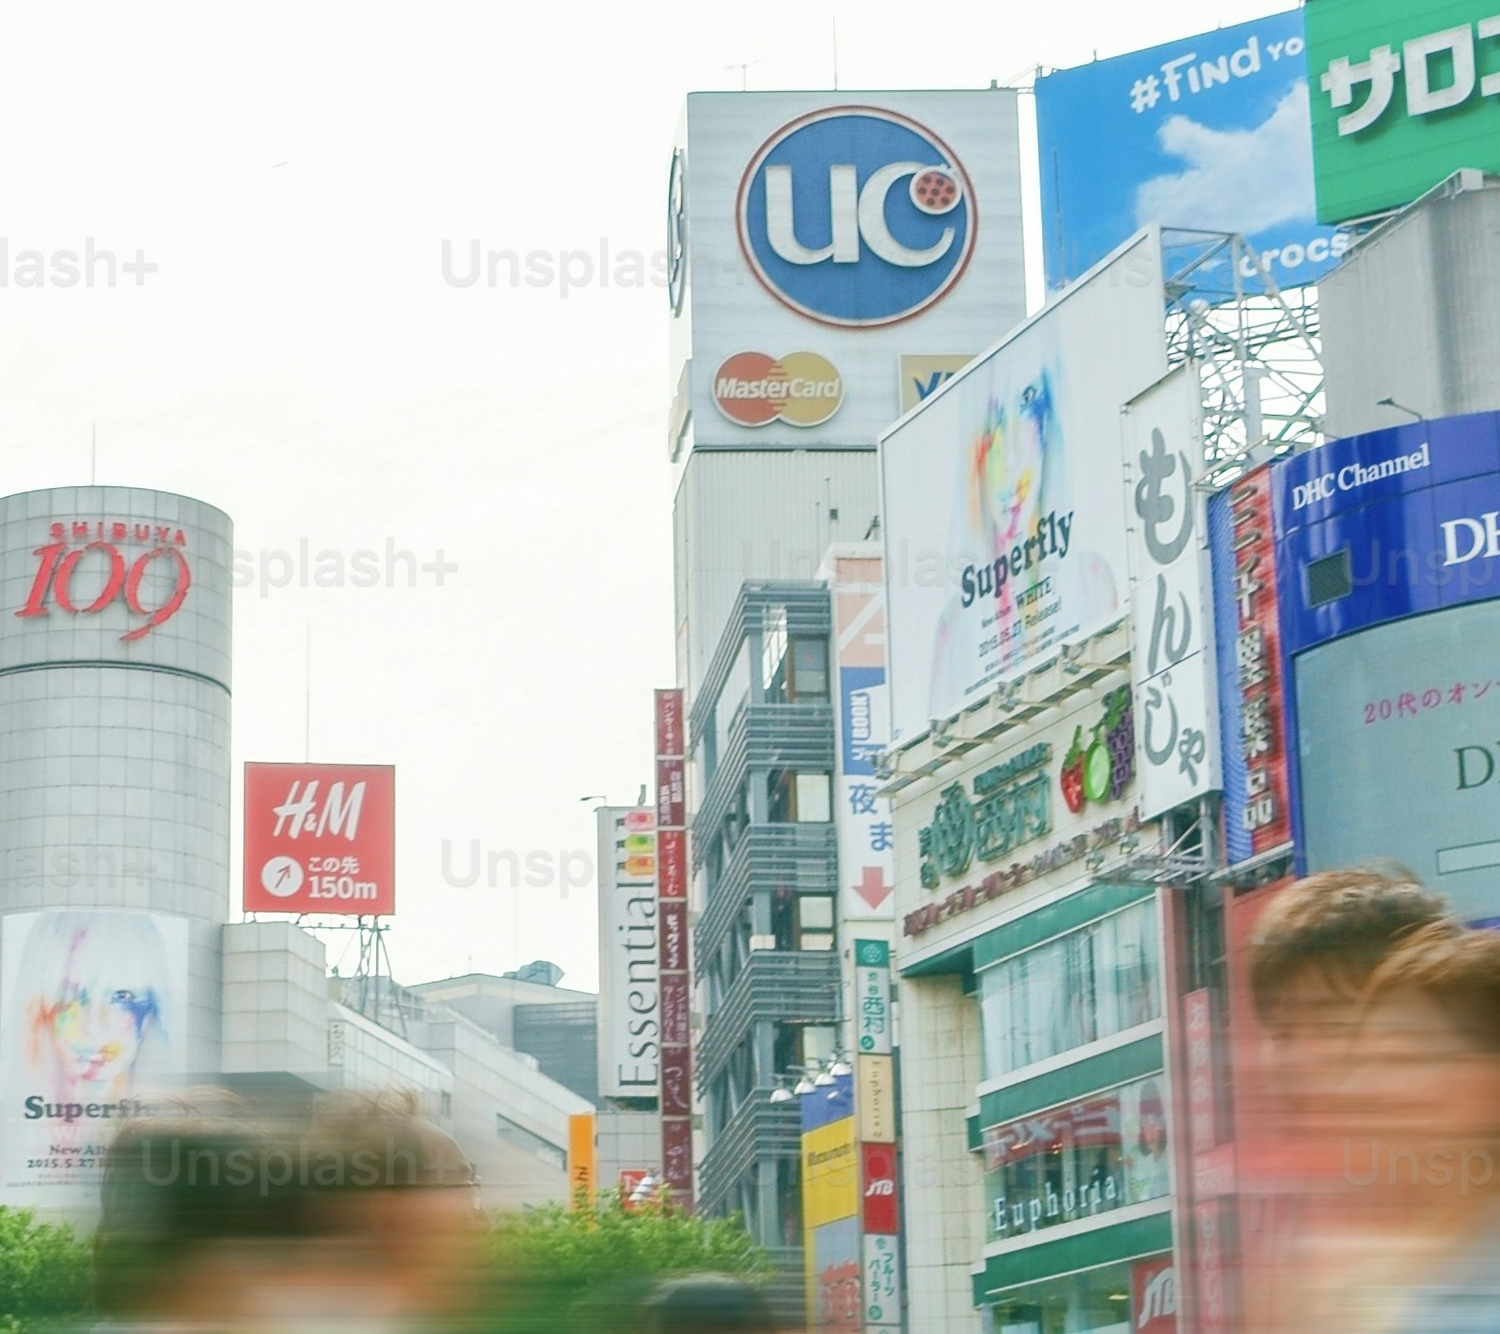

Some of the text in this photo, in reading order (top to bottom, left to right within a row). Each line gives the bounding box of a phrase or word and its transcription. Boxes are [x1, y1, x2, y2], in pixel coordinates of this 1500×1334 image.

[1238, 232, 1350, 279] crocs
[714, 375, 842, 402] MasterCard
[1292, 444, 1431, 512] DHC Channel
[50, 520, 187, 548] SHIBUYA
[961, 509, 1075, 609] Superfly
[13, 540, 192, 642] 109
[1133, 426, 1207, 787] もんじゃ
[273, 779, 367, 842] H&M
[308, 855, 360, 875] この先
[308, 876, 378, 901] 150m
[615, 880, 659, 1089] Essential
[864, 1179, 894, 1198] JTB
[993, 1168, 1117, 1233] Euphoria
